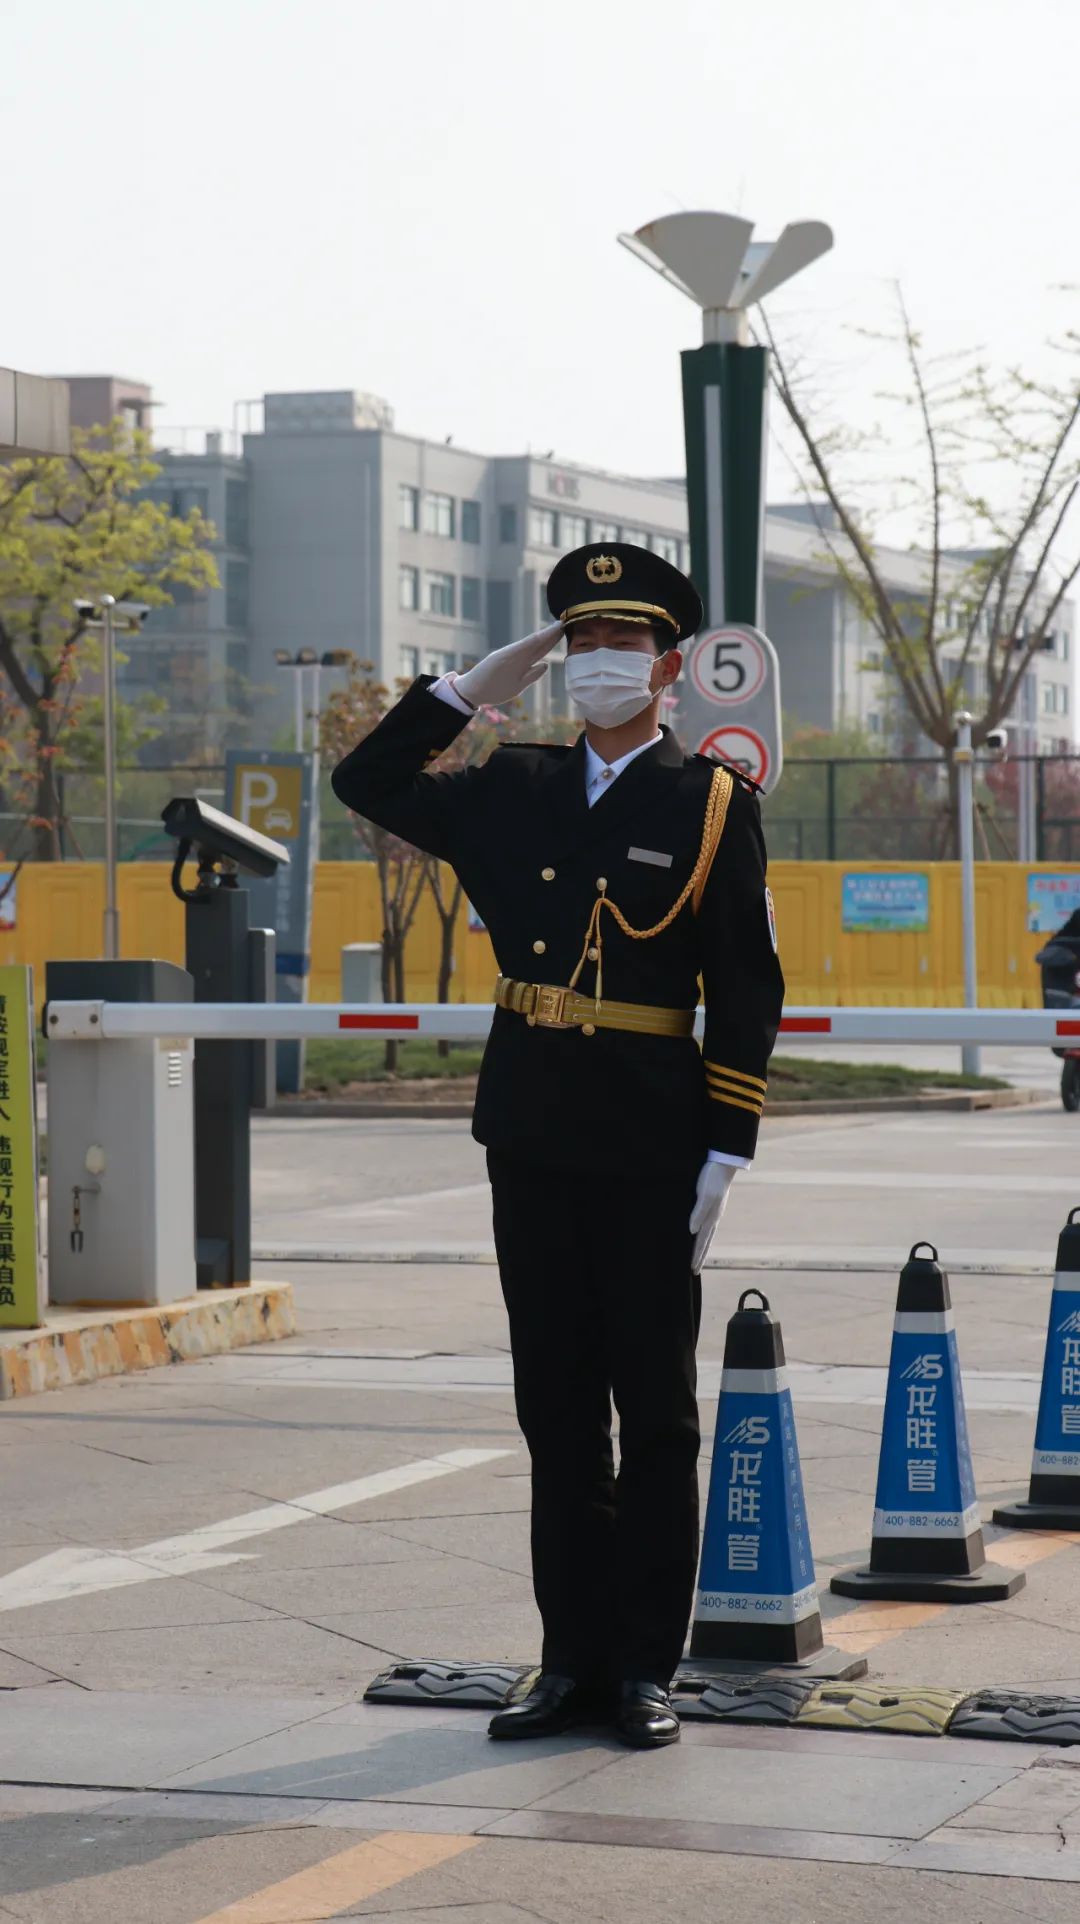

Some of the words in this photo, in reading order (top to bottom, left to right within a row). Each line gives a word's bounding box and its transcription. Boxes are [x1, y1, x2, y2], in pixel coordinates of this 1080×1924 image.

[711, 642, 746, 692] 5
[240, 771, 278, 827] P
[907, 1384, 937, 1492] 龙胜管
[727, 1450, 762, 1571] 龙胜管
[885, 1515, 960, 1527] 400-882-6662
[701, 1596, 783, 1611] 400-882-6662
